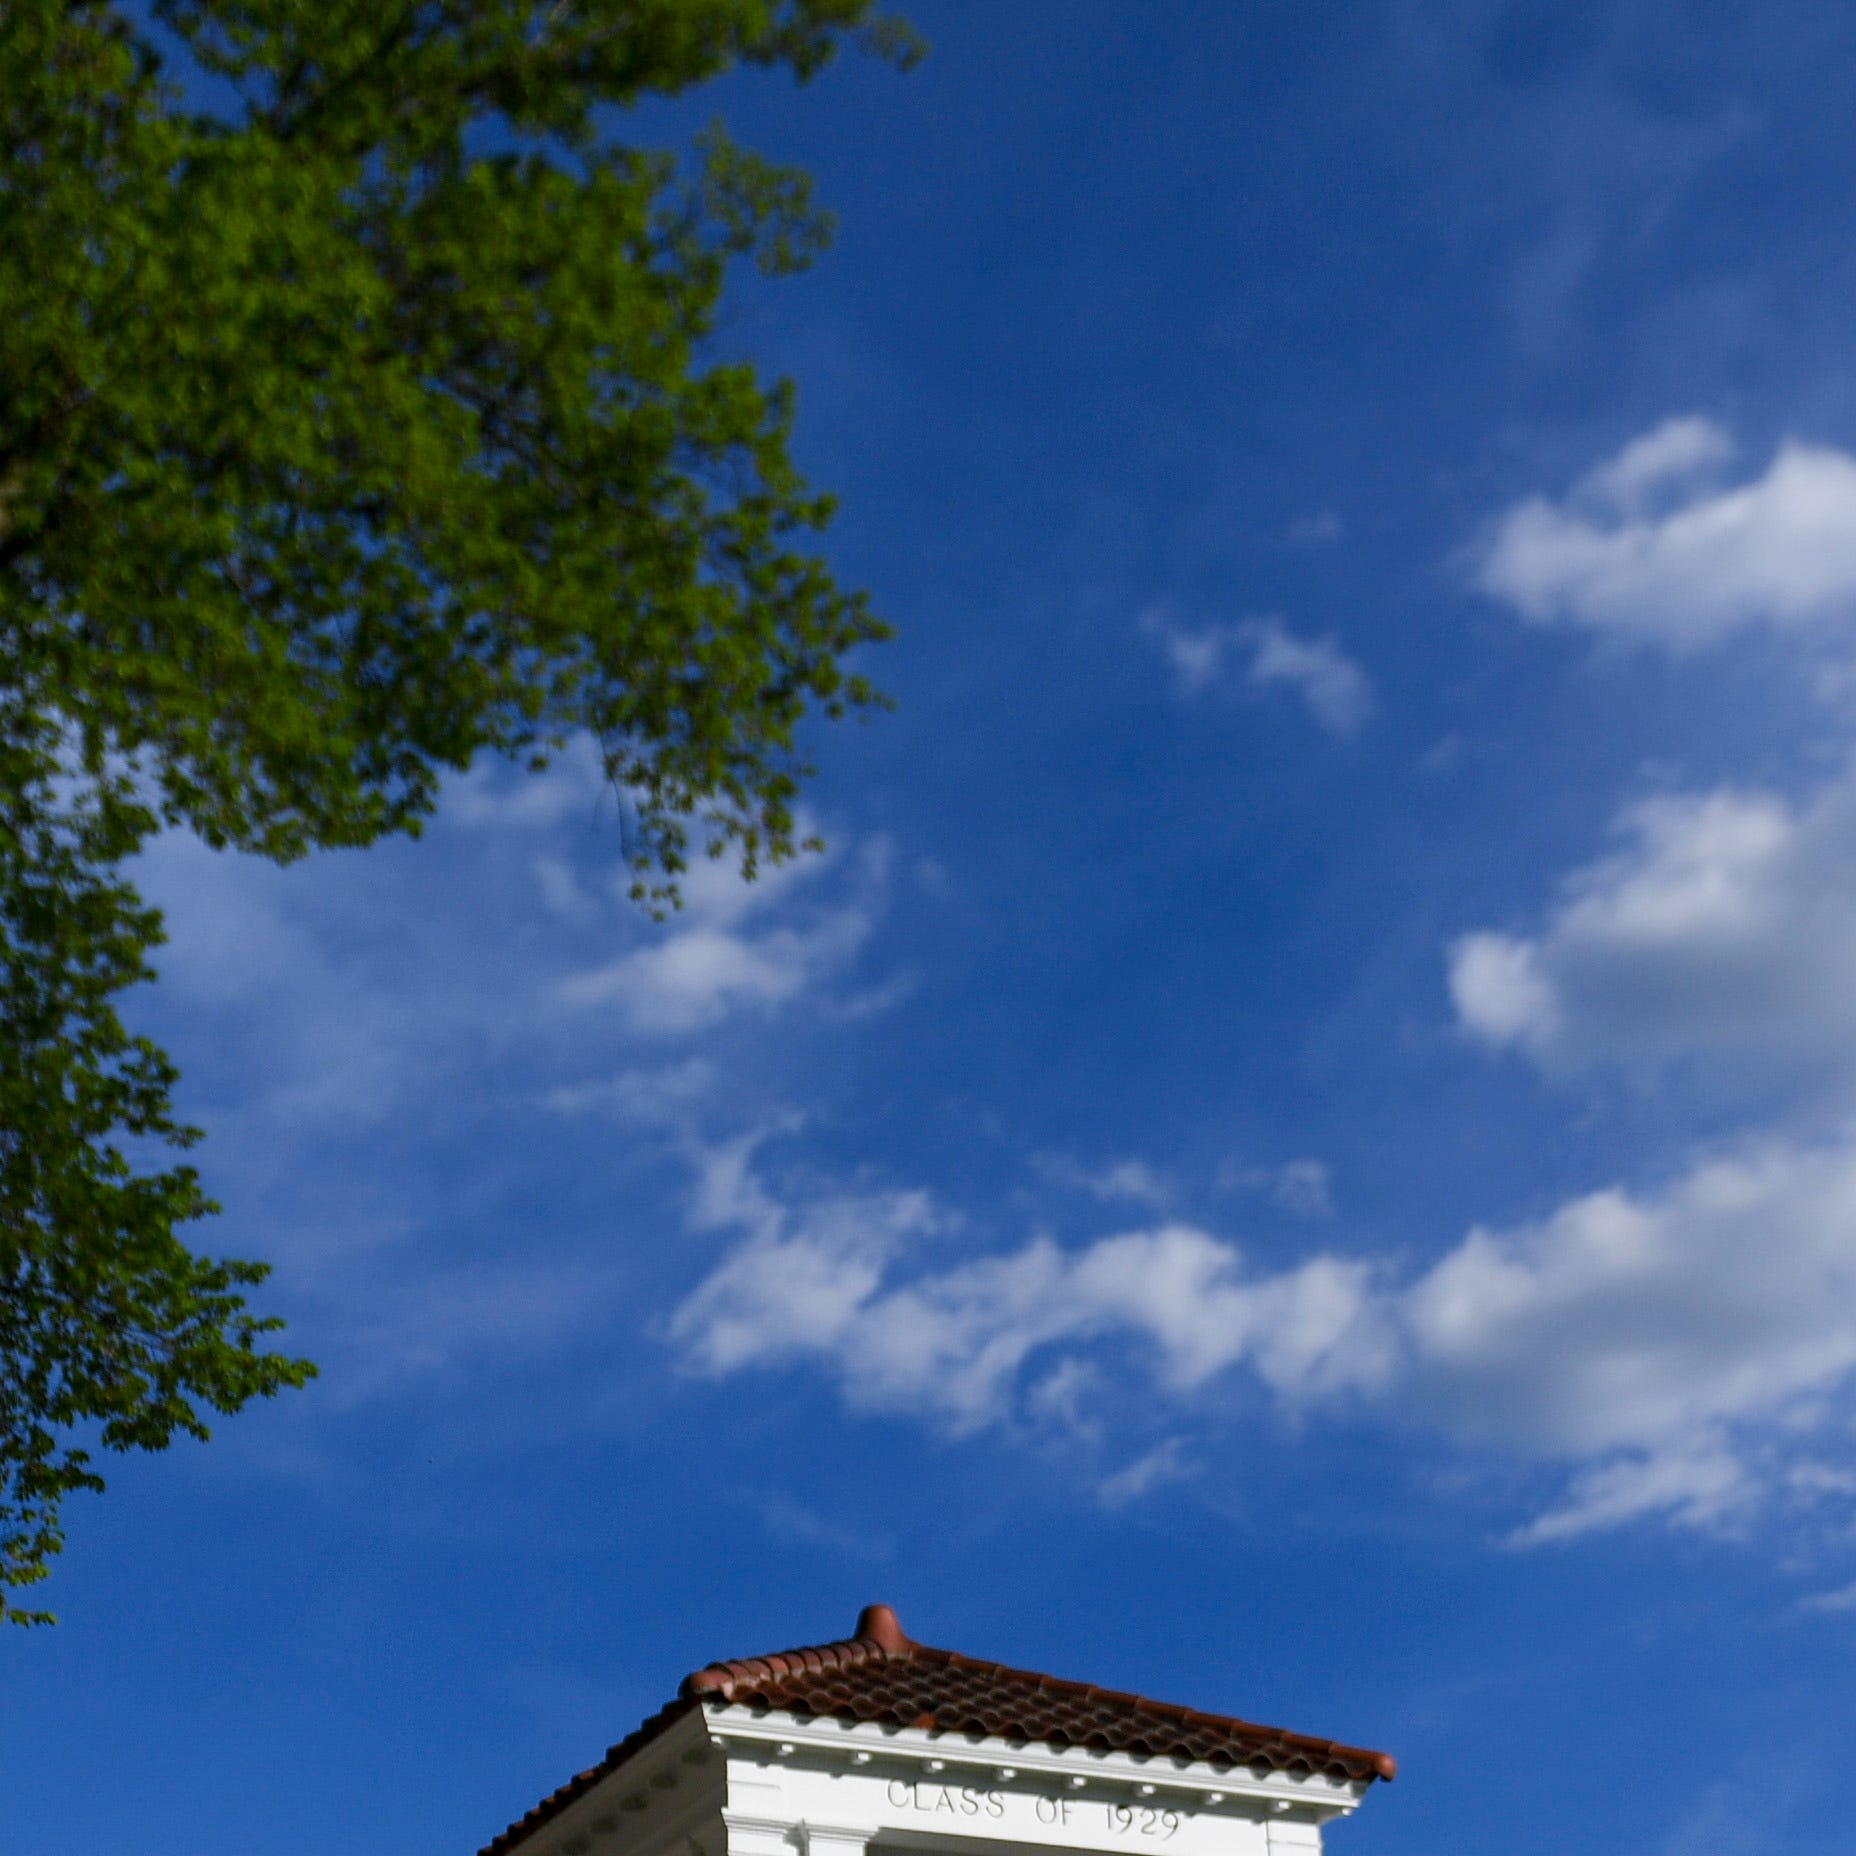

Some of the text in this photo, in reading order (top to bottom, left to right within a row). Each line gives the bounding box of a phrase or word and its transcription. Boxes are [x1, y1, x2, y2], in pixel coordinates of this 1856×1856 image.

[887, 1779, 1180, 1841] CLASS OF 1929
